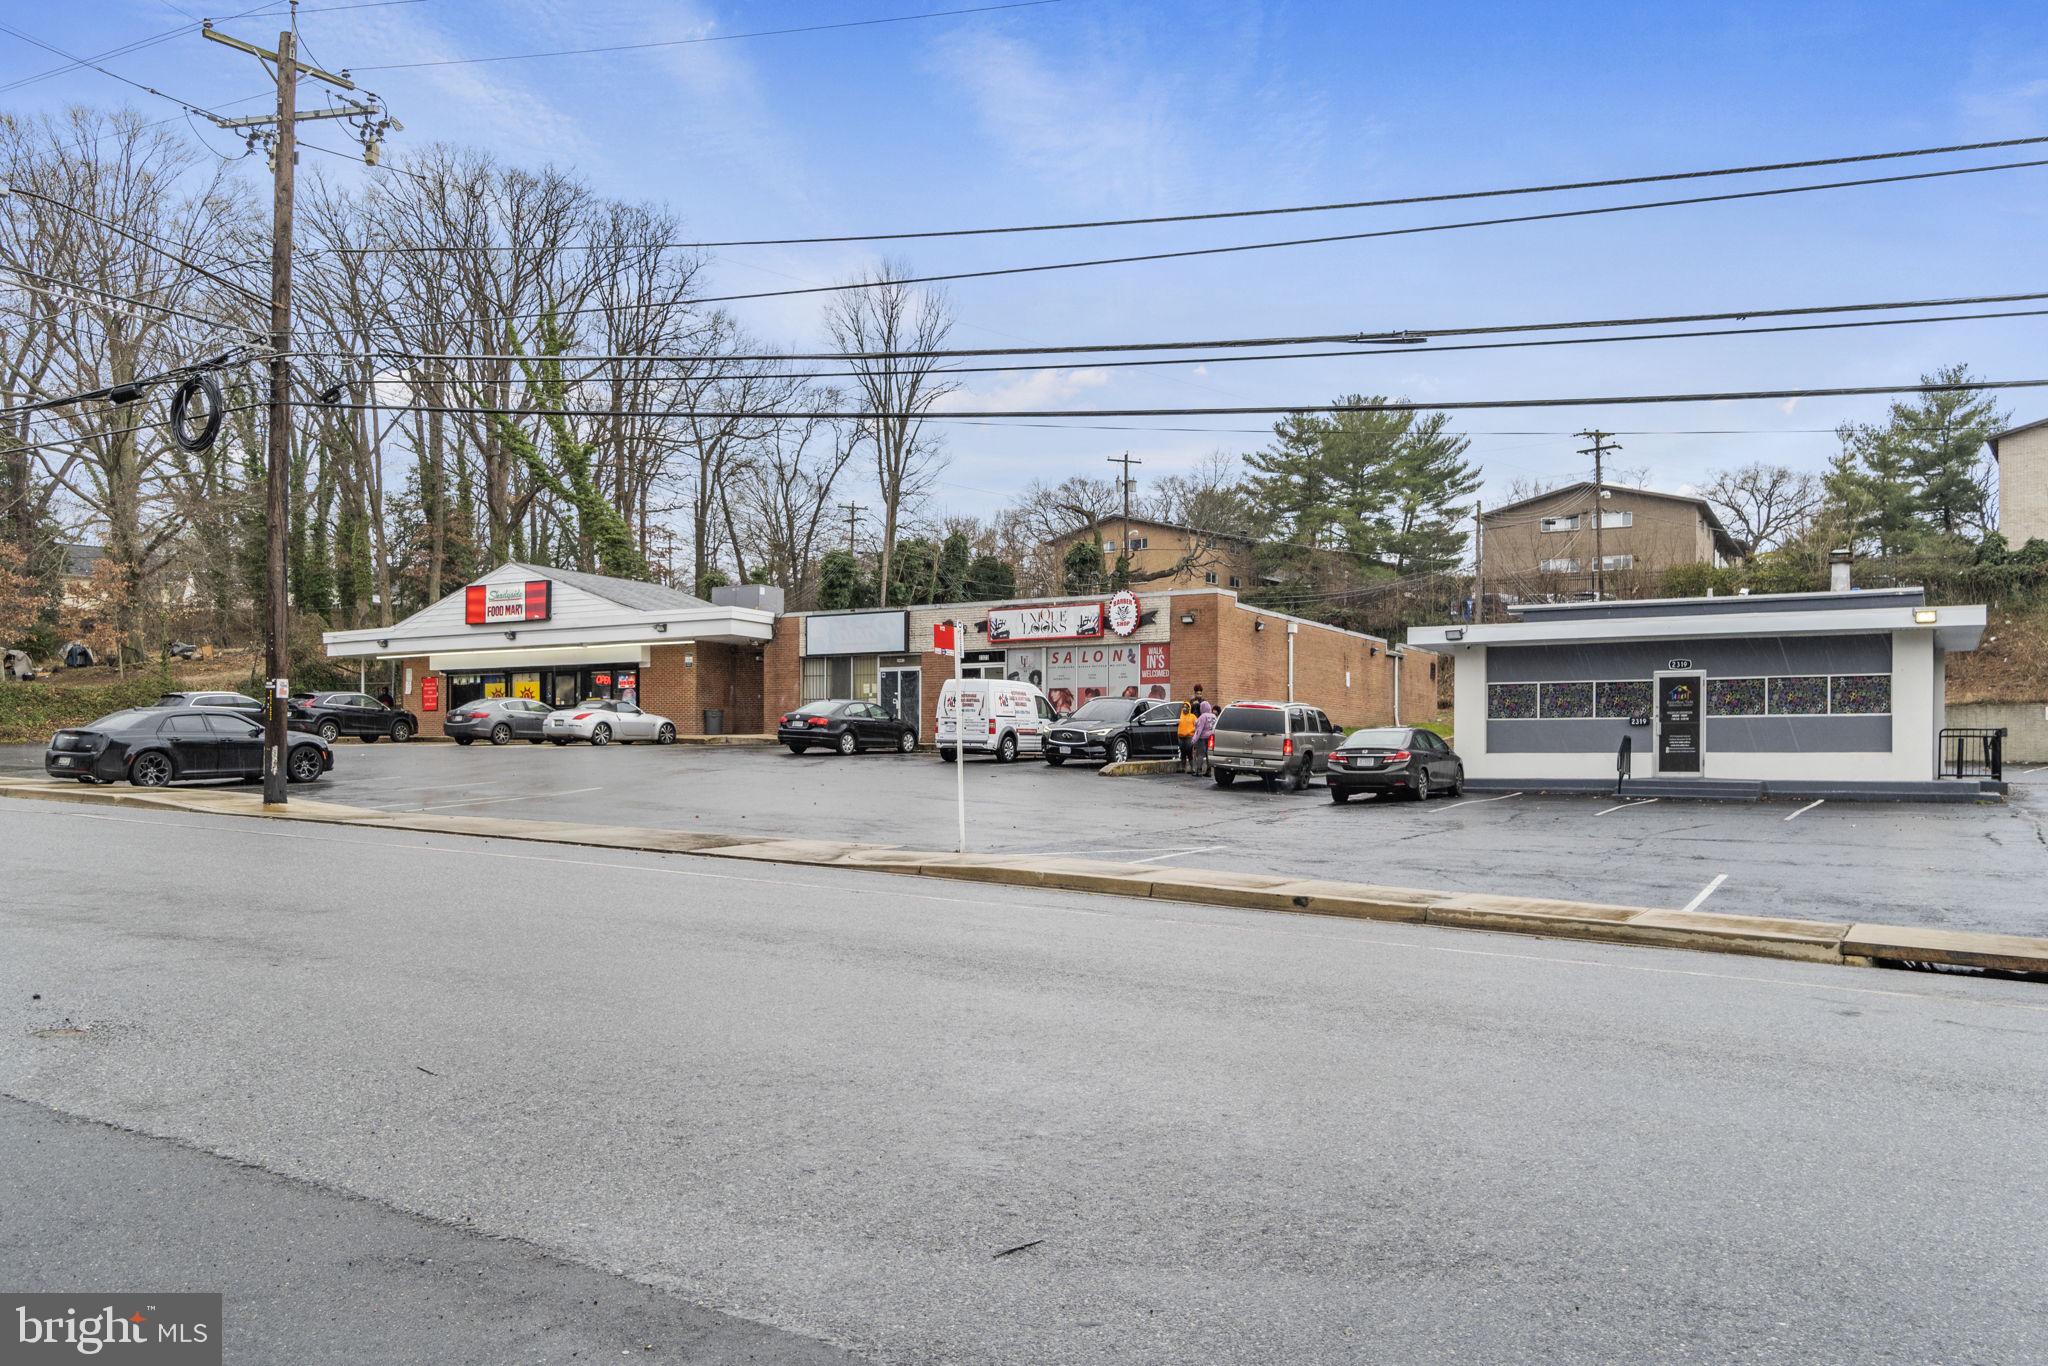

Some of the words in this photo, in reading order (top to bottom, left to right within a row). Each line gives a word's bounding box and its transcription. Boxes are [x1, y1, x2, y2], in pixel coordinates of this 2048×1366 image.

[489, 589, 522, 601] Shadyside
[1113, 598, 1133, 606] BARBER
[487, 605, 504, 617] FOOD
[505, 604, 523, 615] MART
[1020, 607, 1068, 624] UNIQUE
[1022, 622, 1067, 635] LOOKS
[1051, 649, 1124, 664] SALON
[1148, 647, 1163, 655] WALK
[1146, 655, 1165, 669] IN'S
[1141, 669, 1170, 678] WELCOMED
